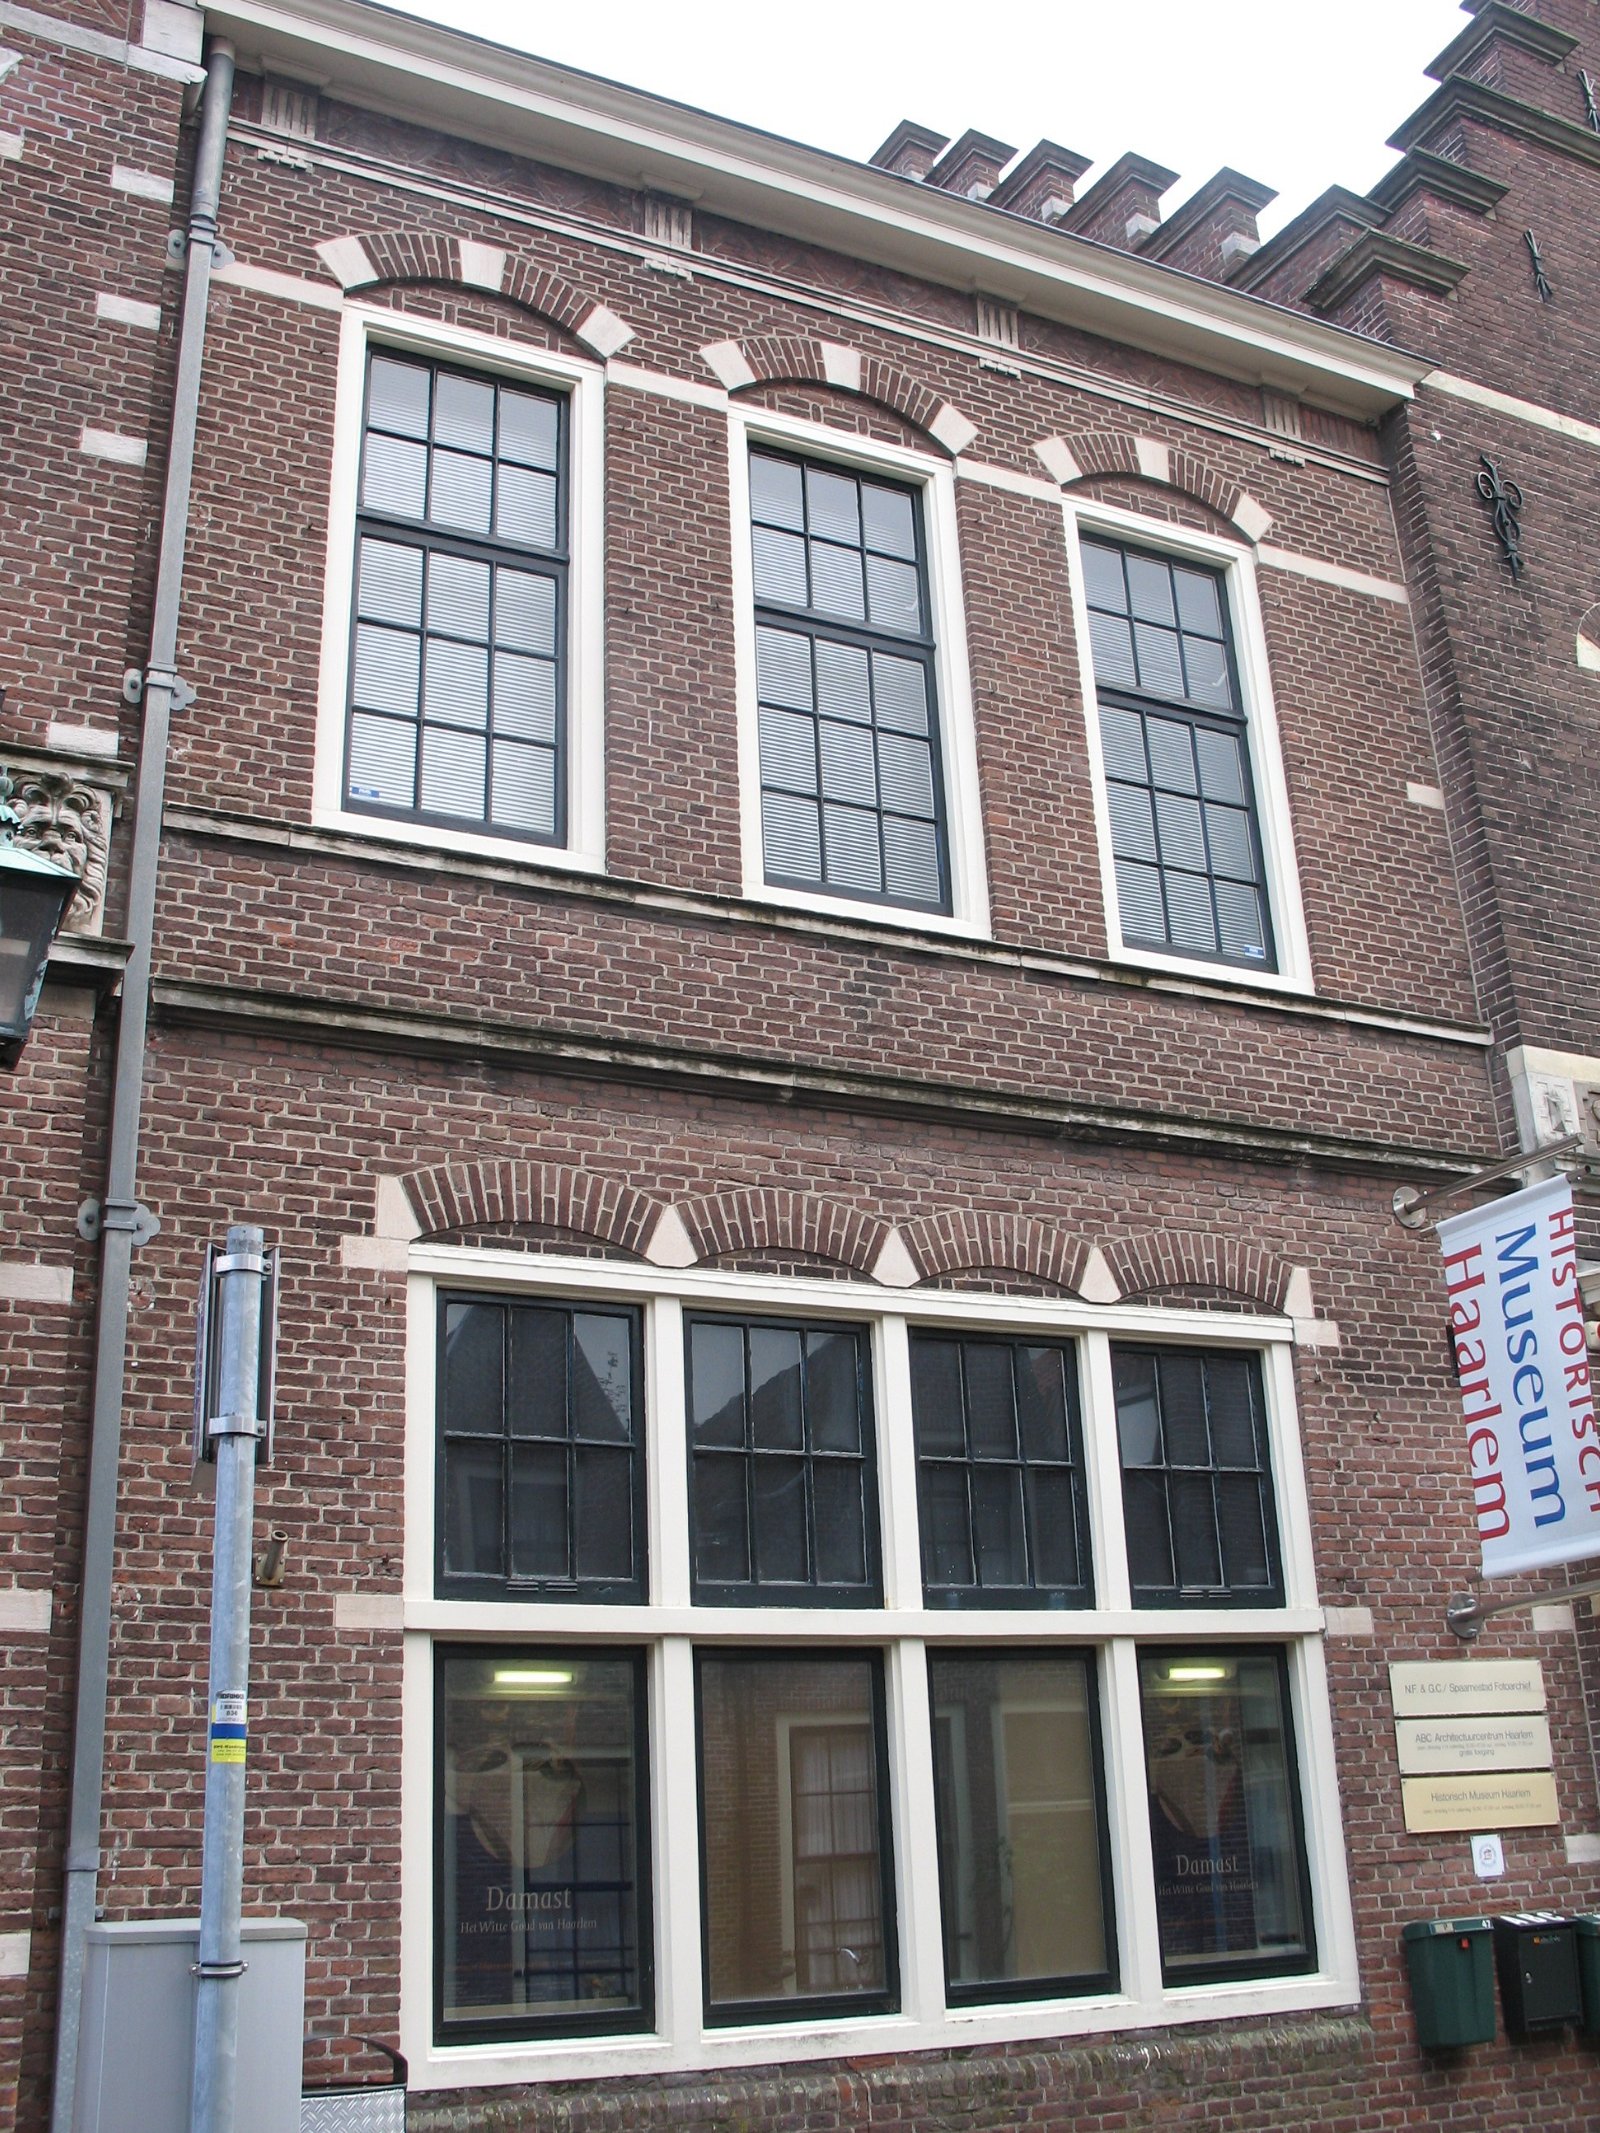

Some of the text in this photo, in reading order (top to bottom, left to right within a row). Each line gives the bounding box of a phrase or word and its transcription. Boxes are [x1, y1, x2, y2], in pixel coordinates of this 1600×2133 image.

[1548, 1206, 1600, 1513] HISTORISCH
[1494, 1223, 1567, 1529] Museum
[1443, 1242, 1511, 1540] Haarlem
[1415, 1729, 1534, 1743] ABC Architectuurcentrum Haarlem
[1431, 1788, 1531, 1802] Historisch Museum Haarlem
[1176, 1854, 1239, 1876] Damast
[485, 1886, 572, 1912] Damast
[460, 1917, 597, 1934] Het Witte Goud van Haarlem
